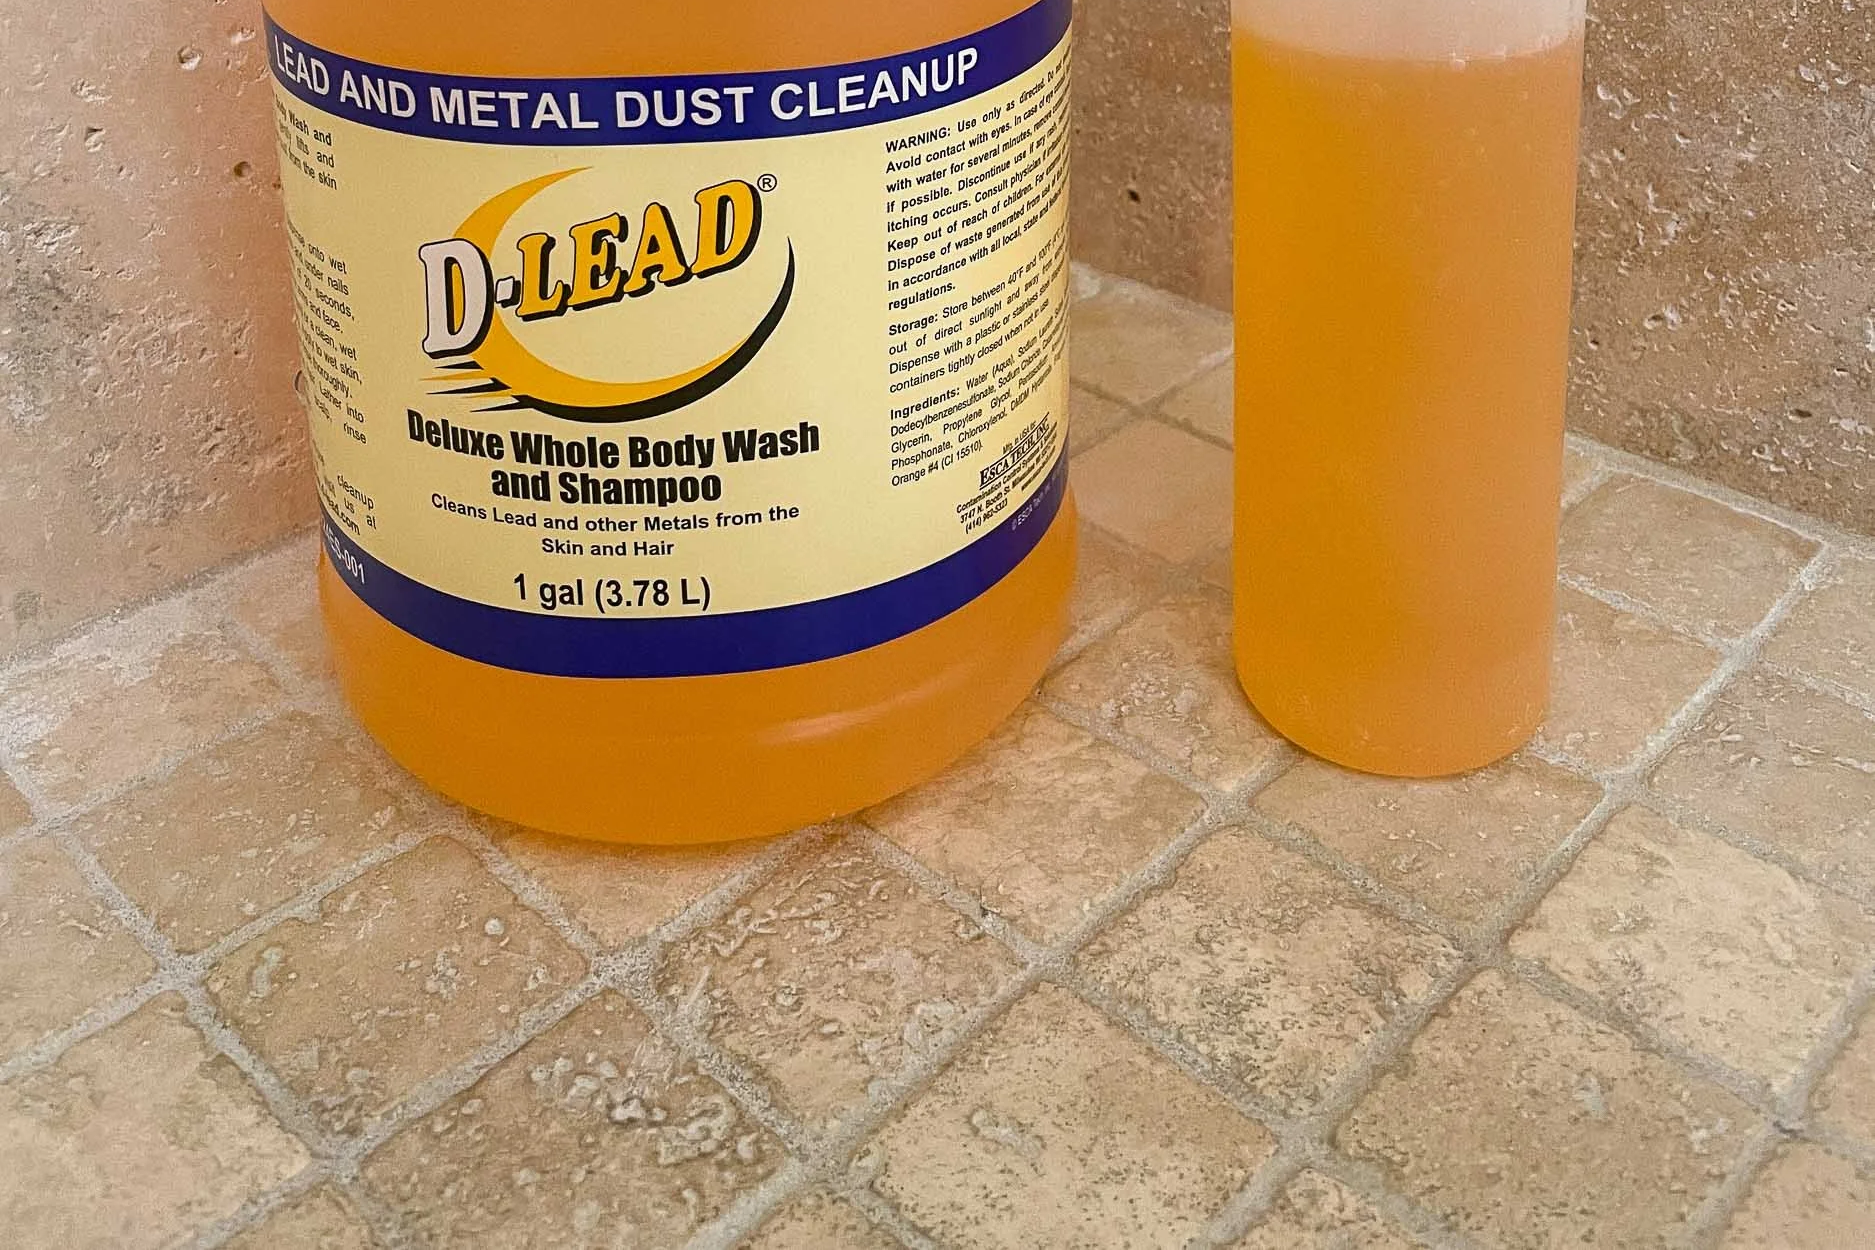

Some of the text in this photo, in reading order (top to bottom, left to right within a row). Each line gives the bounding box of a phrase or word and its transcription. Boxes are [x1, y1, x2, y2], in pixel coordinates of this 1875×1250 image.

[274, 35, 978, 129] LEAD AND METAL DUST CLEANUP
[288, 109, 309, 136] Wash
[313, 130, 332, 146] and
[885, 127, 951, 153] WARNING:
[957, 119, 977, 132] Use
[982, 107, 1001, 123] only
[1006, 100, 1015, 111] as
[886, 154, 922, 174] Avoid
[926, 141, 965, 162] contact
[968, 132, 988, 147] with
[990, 122, 1012, 139] eyes.
[1014, 115, 1022, 126] In
[302, 161, 337, 192] the skin
[317, 151, 335, 168] and
[886, 178, 912, 193] with
[916, 168, 947, 185] water
[950, 162, 965, 174] for
[967, 144, 1000, 168] several
[887, 213, 928, 233] itching
[932, 199, 972, 220] occurs.
[974, 178, 1008, 203] Consult
[1010, 157, 1041, 189] physician
[901, 186, 953, 213] possible.
[957, 160, 1011, 192] Discontinue
[1013, 150, 1027, 164] use
[887, 236, 919, 253] Keep
[923, 226, 942, 242] out
[946, 220, 958, 234] of
[961, 208, 988, 229] reach
[991, 200, 1001, 215] of
[1003, 183, 1033, 208] children.
[1034, 171, 1045, 186] For
[887, 250, 936, 272] Dispose
[940, 241, 952, 256] of
[954, 231, 983, 251] waste
[986, 204, 1025, 239] generated
[1026, 194, 1041, 212] from
[328, 255, 347, 275] wet
[887, 279, 900, 292] in
[902, 258, 967, 288] accordance
[968, 246, 989, 263] with
[990, 238, 1001, 253] all
[1023, 214, 1039, 232] state
[327, 276, 349, 295] nails
[888, 313, 939, 336] Storage:
[942, 301, 968, 319] Store
[971, 281, 1006, 307] between
[1025, 255, 1037, 273] and
[888, 282, 956, 310] regulations.
[888, 341, 908, 356] out
[915, 334, 927, 348] of
[934, 320, 963, 341] direct
[969, 300, 1002, 326] sunlight
[1006, 286, 1021, 305] and
[889, 350, 940, 374] Dispense
[943, 339, 963, 356] with
[966, 336, 972, 346] a
[974, 320, 1002, 345] plastic
[1002, 313, 1011, 325] or
[1012, 291, 1039, 319] stainless
[323, 351, 338, 370] wet
[339, 342, 358, 361] wet
[889, 367, 946, 393] containers
[948, 353, 976, 373] tightly
[977, 335, 1003, 359] closed
[1004, 323, 1023, 342] when
[1023, 313, 1034, 328] not
[890, 387, 960, 420] Ingredients:
[966, 371, 989, 390] Water
[998, 366, 1021, 389] Sodium
[345, 403, 364, 423] into
[943, 408, 983, 434] Propylene
[343, 422, 367, 444] rinse
[407, 409, 820, 469] Deluxe Whole Body Wash
[491, 469, 722, 507] and Shampoo
[891, 468, 926, 487] Orange
[928, 460, 939, 474] #4
[941, 453, 954, 470] (CI
[979, 458, 1010, 488] ESCA
[336, 474, 374, 511] cleanup
[956, 481, 1002, 514] Contamination
[960, 507, 976, 524] 3747
[985, 491, 1003, 509] Booth
[343, 496, 377, 530] us at
[431, 493, 800, 532] Cleans Lead and other Metals from the
[541, 537, 675, 557] Skin and Hair
[513, 572, 711, 614] 1 gal (3.78 L)
